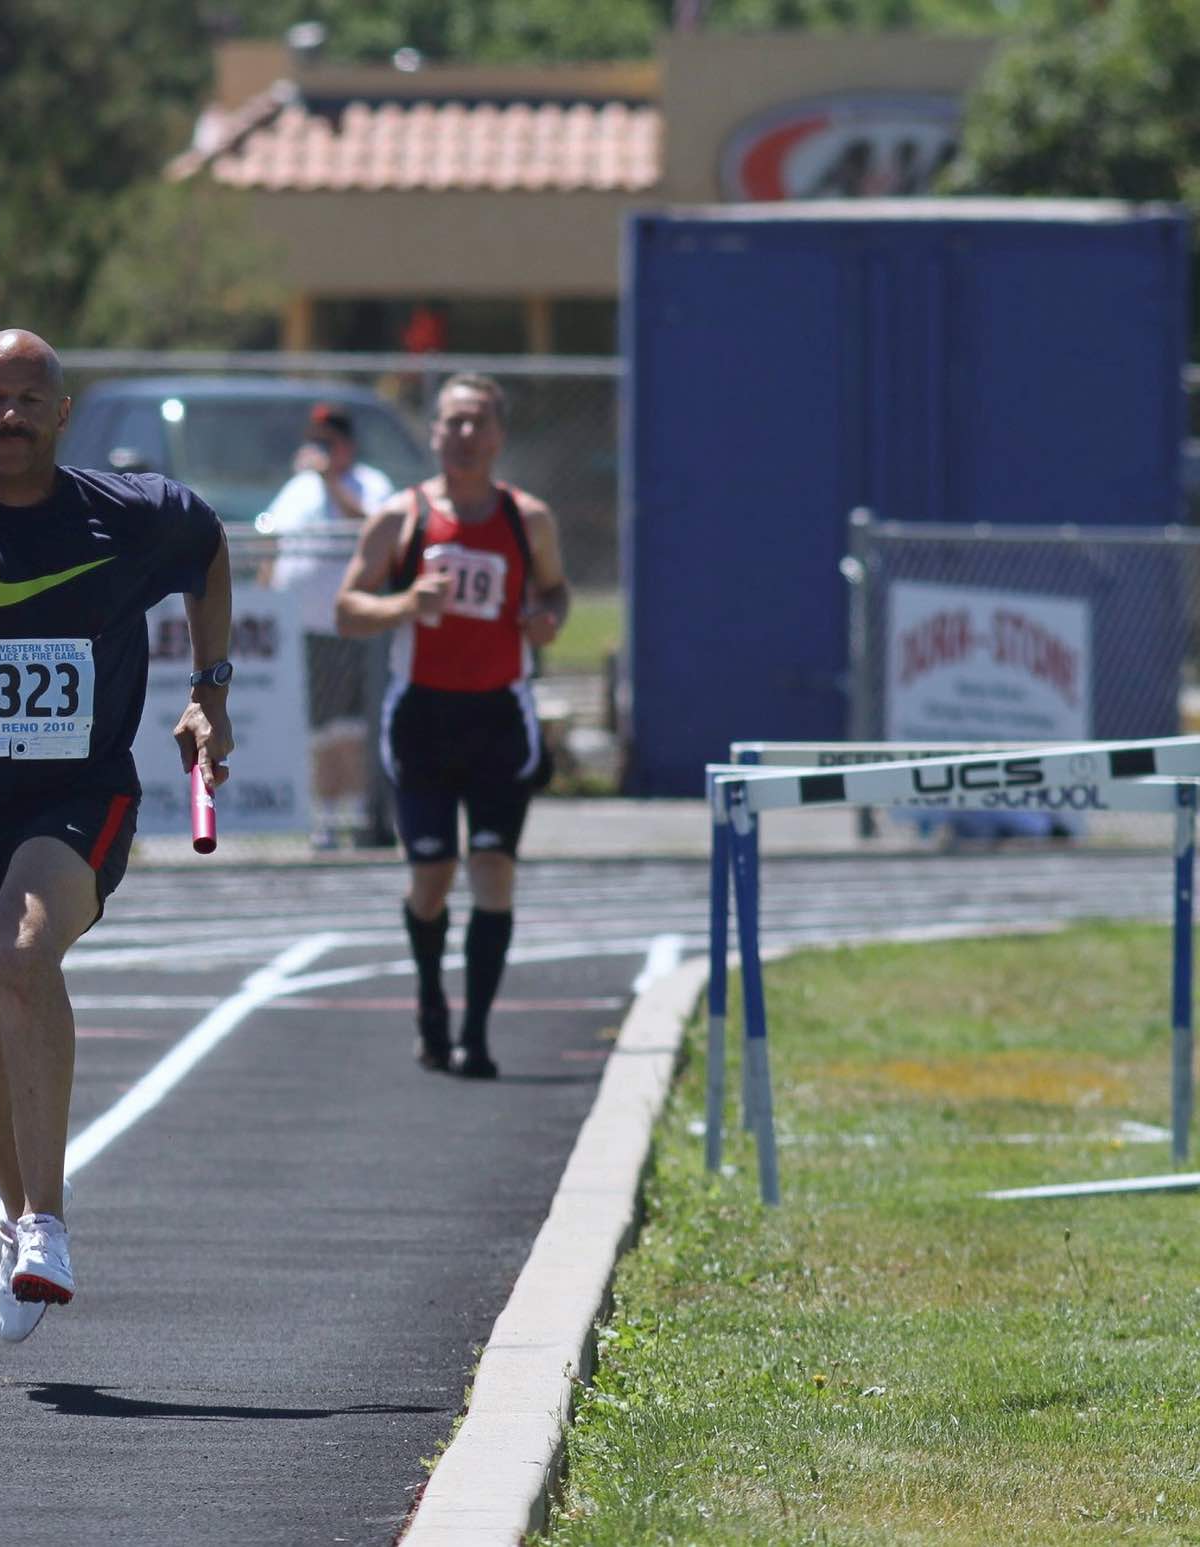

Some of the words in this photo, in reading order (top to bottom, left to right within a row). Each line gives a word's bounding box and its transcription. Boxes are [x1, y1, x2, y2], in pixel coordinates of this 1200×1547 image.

[439, 565, 491, 605] 19
[44, 643, 76, 652] STATES
[22, 652, 28, 661] &
[32, 652, 52, 661] FIRE
[55, 651, 86, 661] GAMES
[1, 723, 39, 733] RENO
[43, 721, 75, 732] 2010
[912, 758, 1044, 794] UCS
